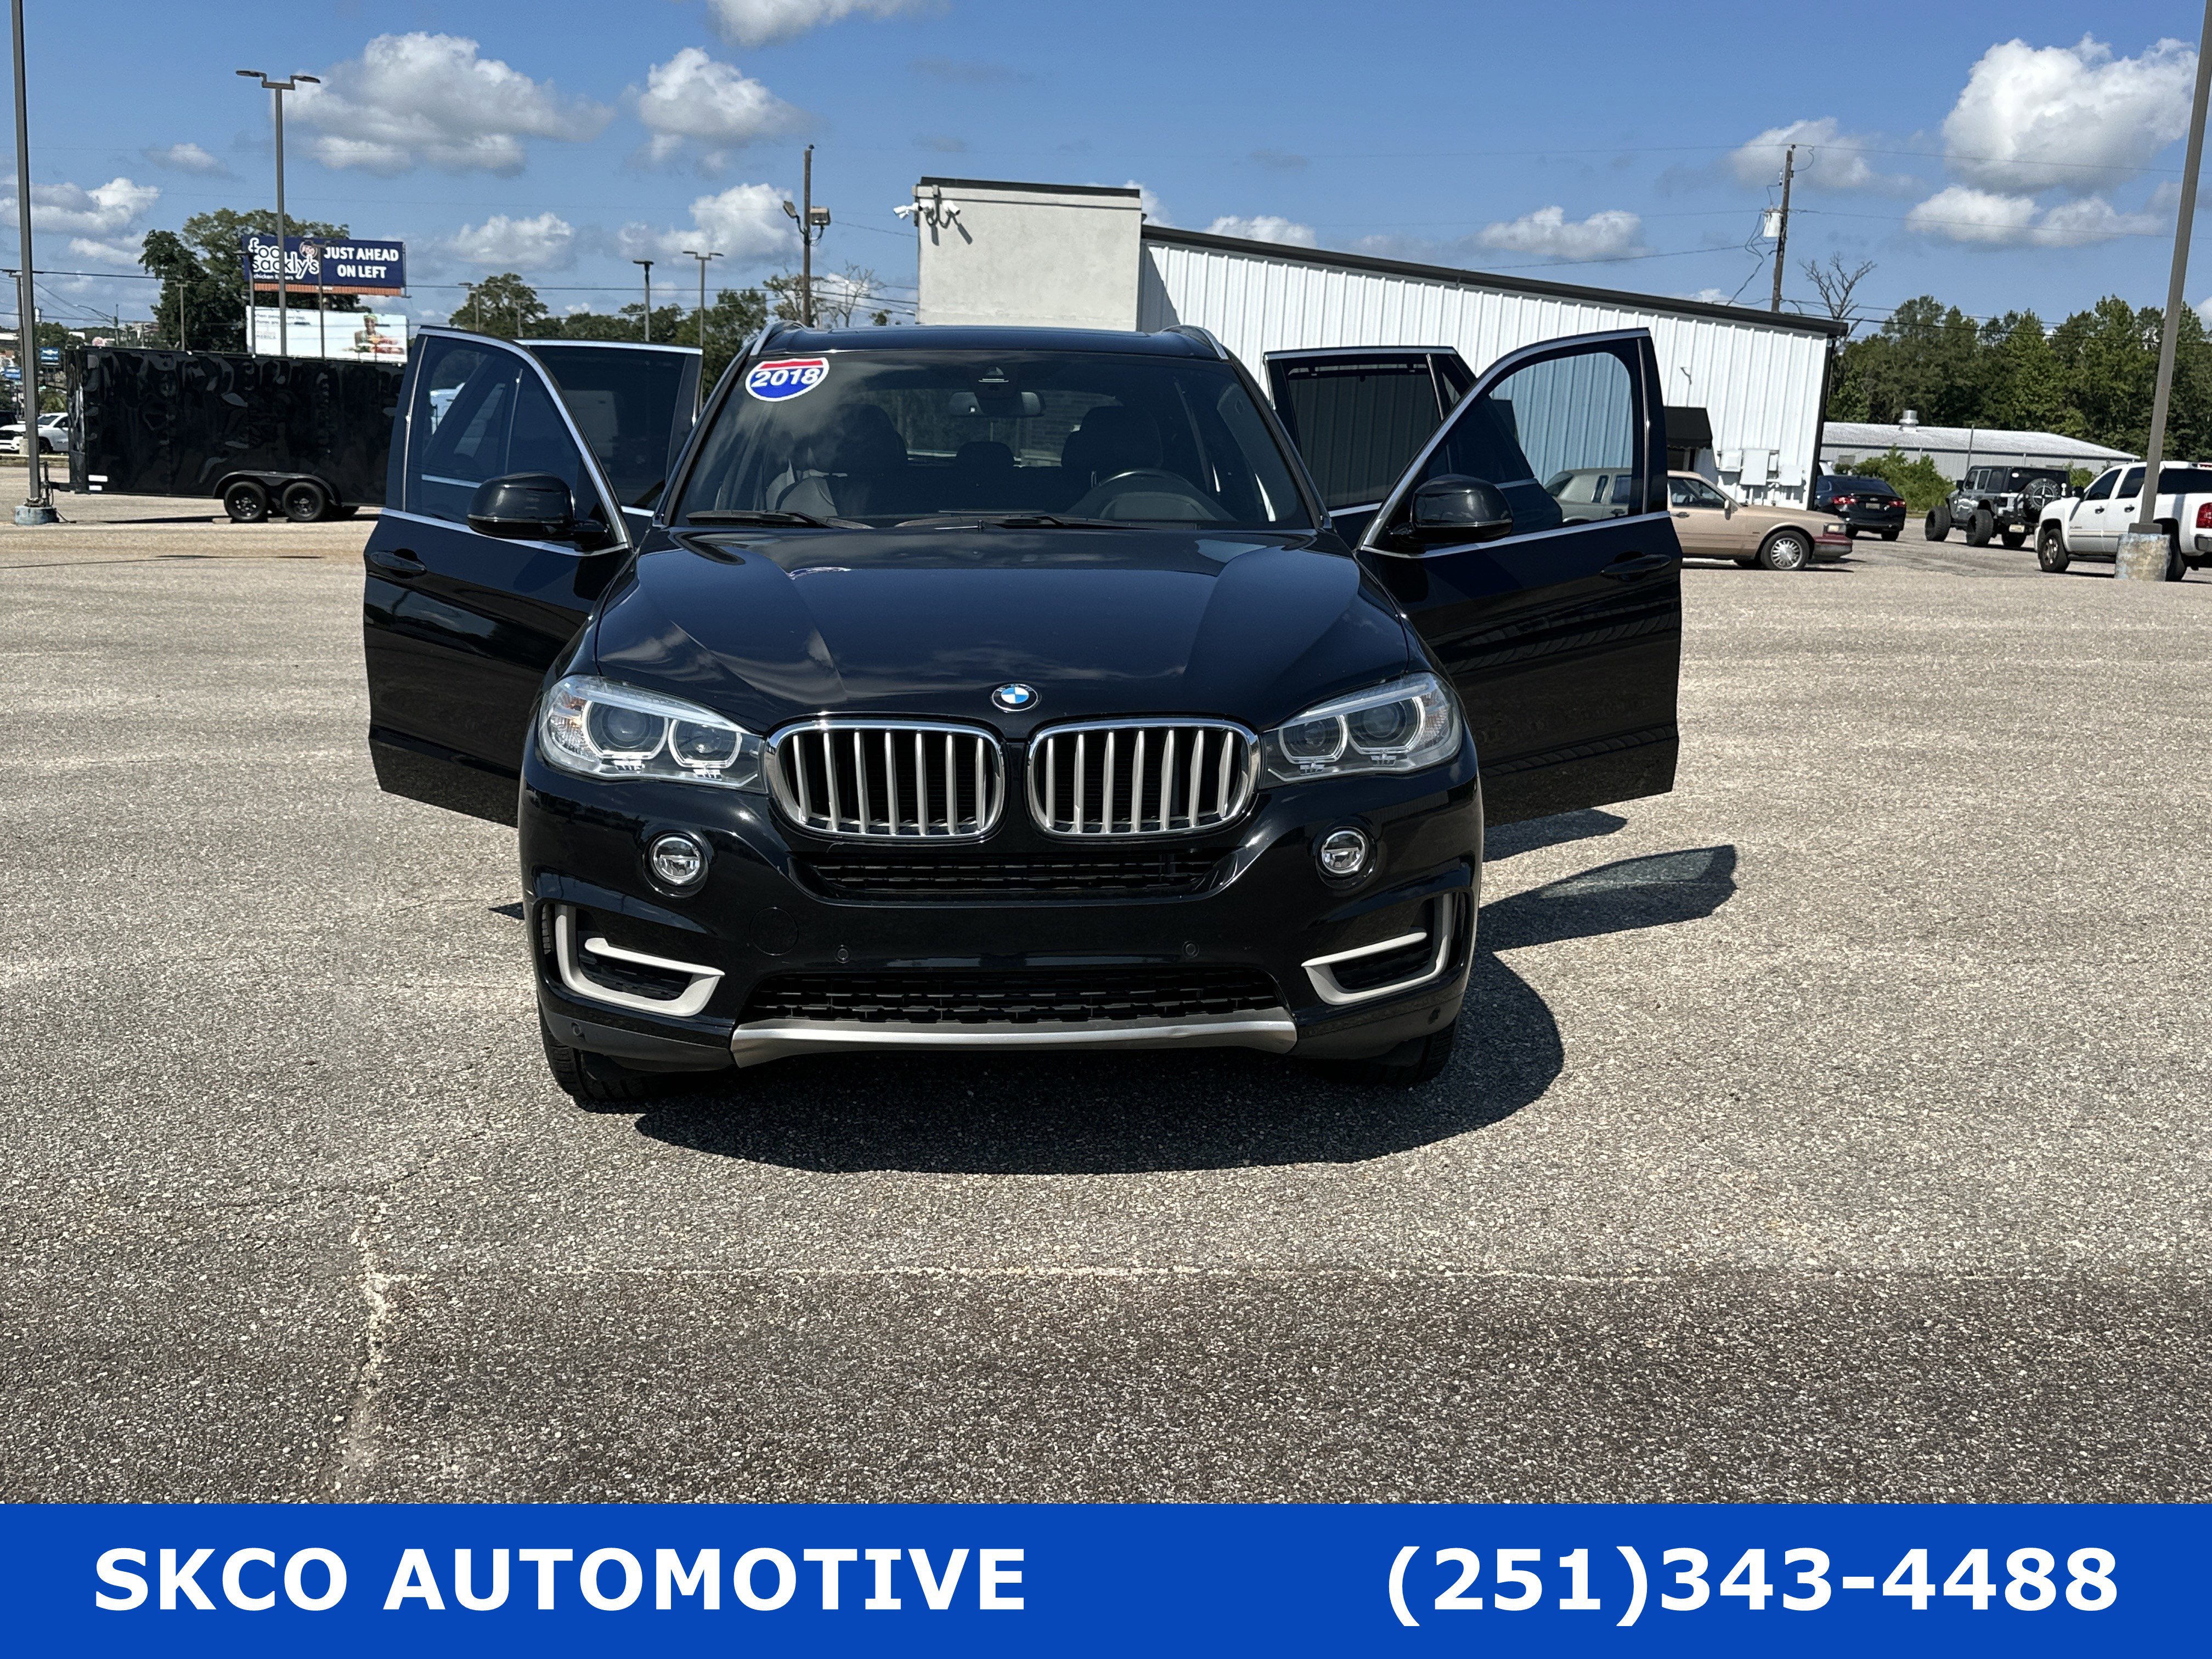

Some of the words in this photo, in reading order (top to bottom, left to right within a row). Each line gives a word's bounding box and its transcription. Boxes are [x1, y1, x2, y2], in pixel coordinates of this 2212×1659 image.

[324, 246, 354, 259] JUST
[357, 248, 399, 261] AHEAD
[337, 264, 356, 277] ON
[358, 266, 387, 279] LEFT
[751, 368, 820, 388] 2018
